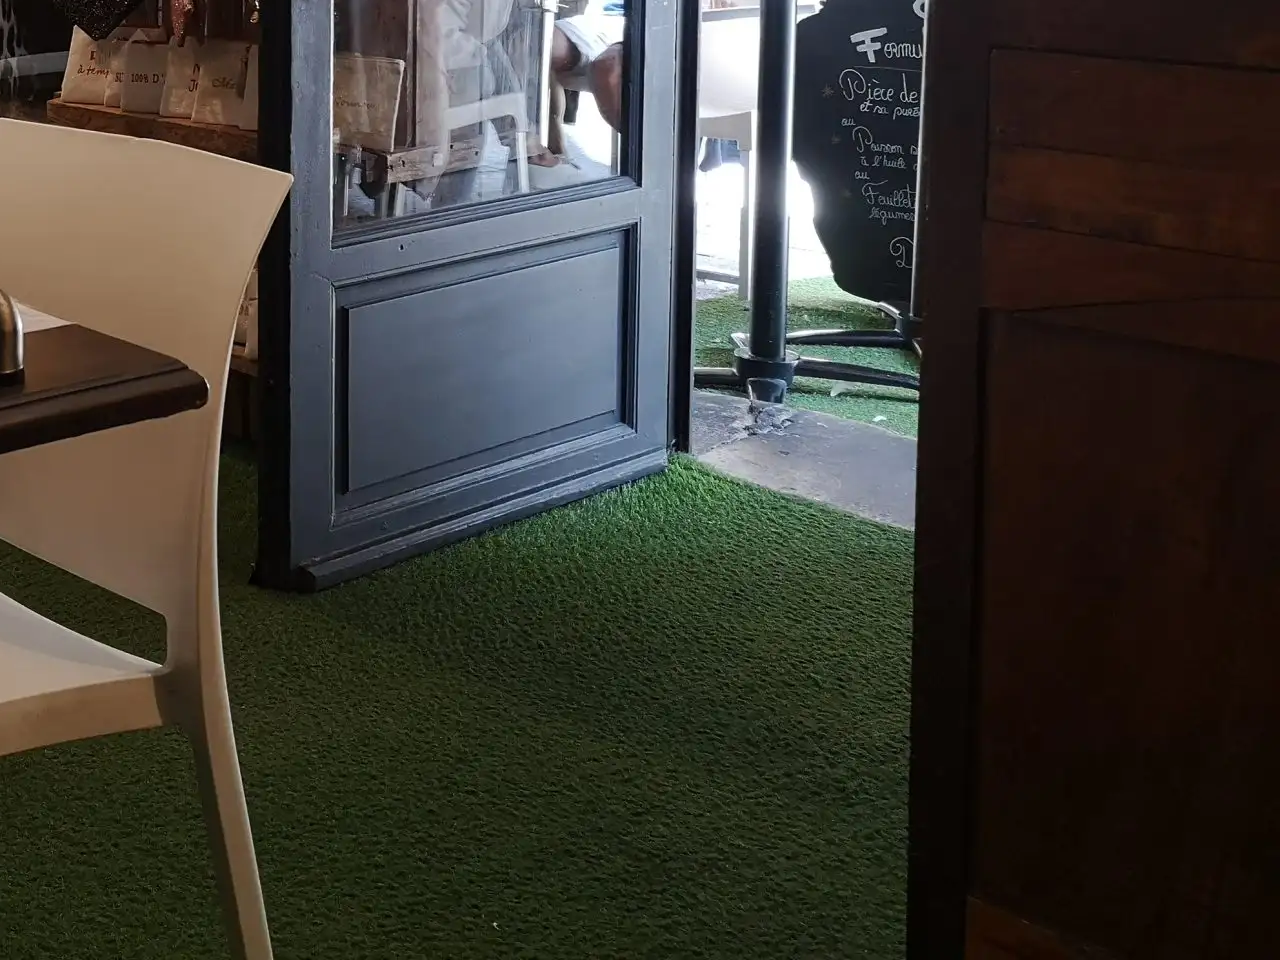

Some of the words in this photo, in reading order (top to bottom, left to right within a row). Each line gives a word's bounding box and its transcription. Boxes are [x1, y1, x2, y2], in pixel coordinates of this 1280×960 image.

[850, 26, 923, 63] Formu
[839, 68, 894, 102] Pièce
[900, 72, 919, 104] de
[860, 100, 873, 112] et
[893, 106, 920, 121] puré
[862, 179, 917, 209] Feuillet
